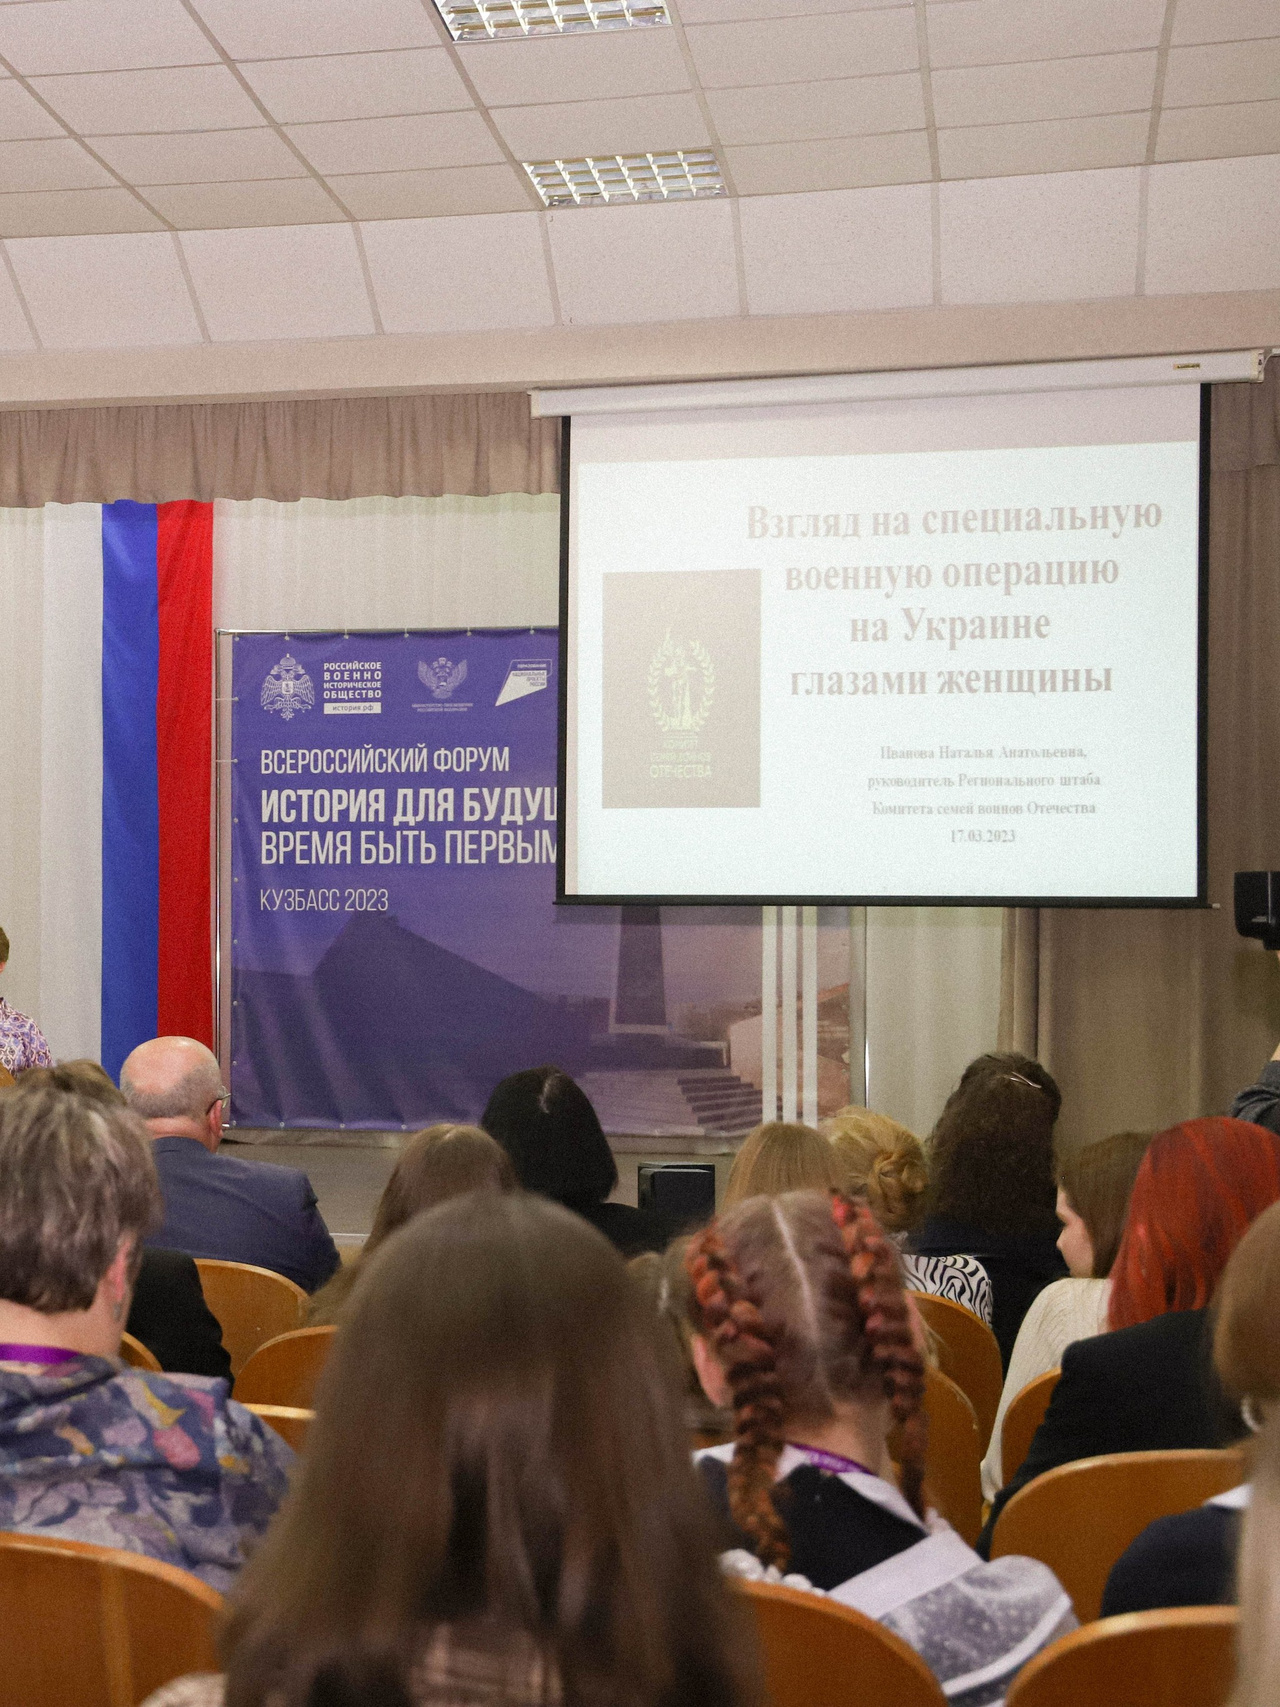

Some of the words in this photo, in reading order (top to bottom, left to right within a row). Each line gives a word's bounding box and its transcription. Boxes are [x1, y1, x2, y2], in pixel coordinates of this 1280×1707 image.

[746, 505, 861, 539] Взгляд
[871, 511, 910, 537] на
[922, 502, 1163, 539] специальную
[785, 564, 933, 599] военную
[942, 559, 1120, 596] операцию
[850, 618, 889, 642] на
[901, 606, 1051, 651] Украине
[323, 660, 382, 671] РОССИЙСКОЕ
[323, 670, 382, 681] ВОЕННО
[323, 681, 382, 689] ИСТОРИЧЕСКОЕ
[790, 670, 927, 696] глазами
[936, 667, 1113, 696] женщины
[323, 690, 382, 700] ОБЩЕСТВО
[260, 743, 428, 775] ВСЕРОССИЙСКИЙ
[433, 746, 510, 773] ФОРУМ
[880, 745, 935, 760] Иванова
[938, 745, 994, 759] Наталья
[867, 777, 955, 791] руководитель
[957, 773, 1055, 787] Регионального
[1059, 772, 1101, 786] штаба
[261, 788, 385, 823] ИСТОРИЯ
[393, 787, 455, 827] ДЛЯ
[872, 801, 934, 815] Комитета
[936, 802, 974, 815] семей
[977, 804, 1023, 815] воинов
[1027, 801, 1096, 815] Отечества
[951, 829, 1016, 843] 17.03.2023
[261, 830, 352, 865] ВРЕМЯ
[360, 830, 437, 864] БЫТЬ
[260, 888, 340, 912] КУЗБАСС
[344, 888, 389, 911] 2023
